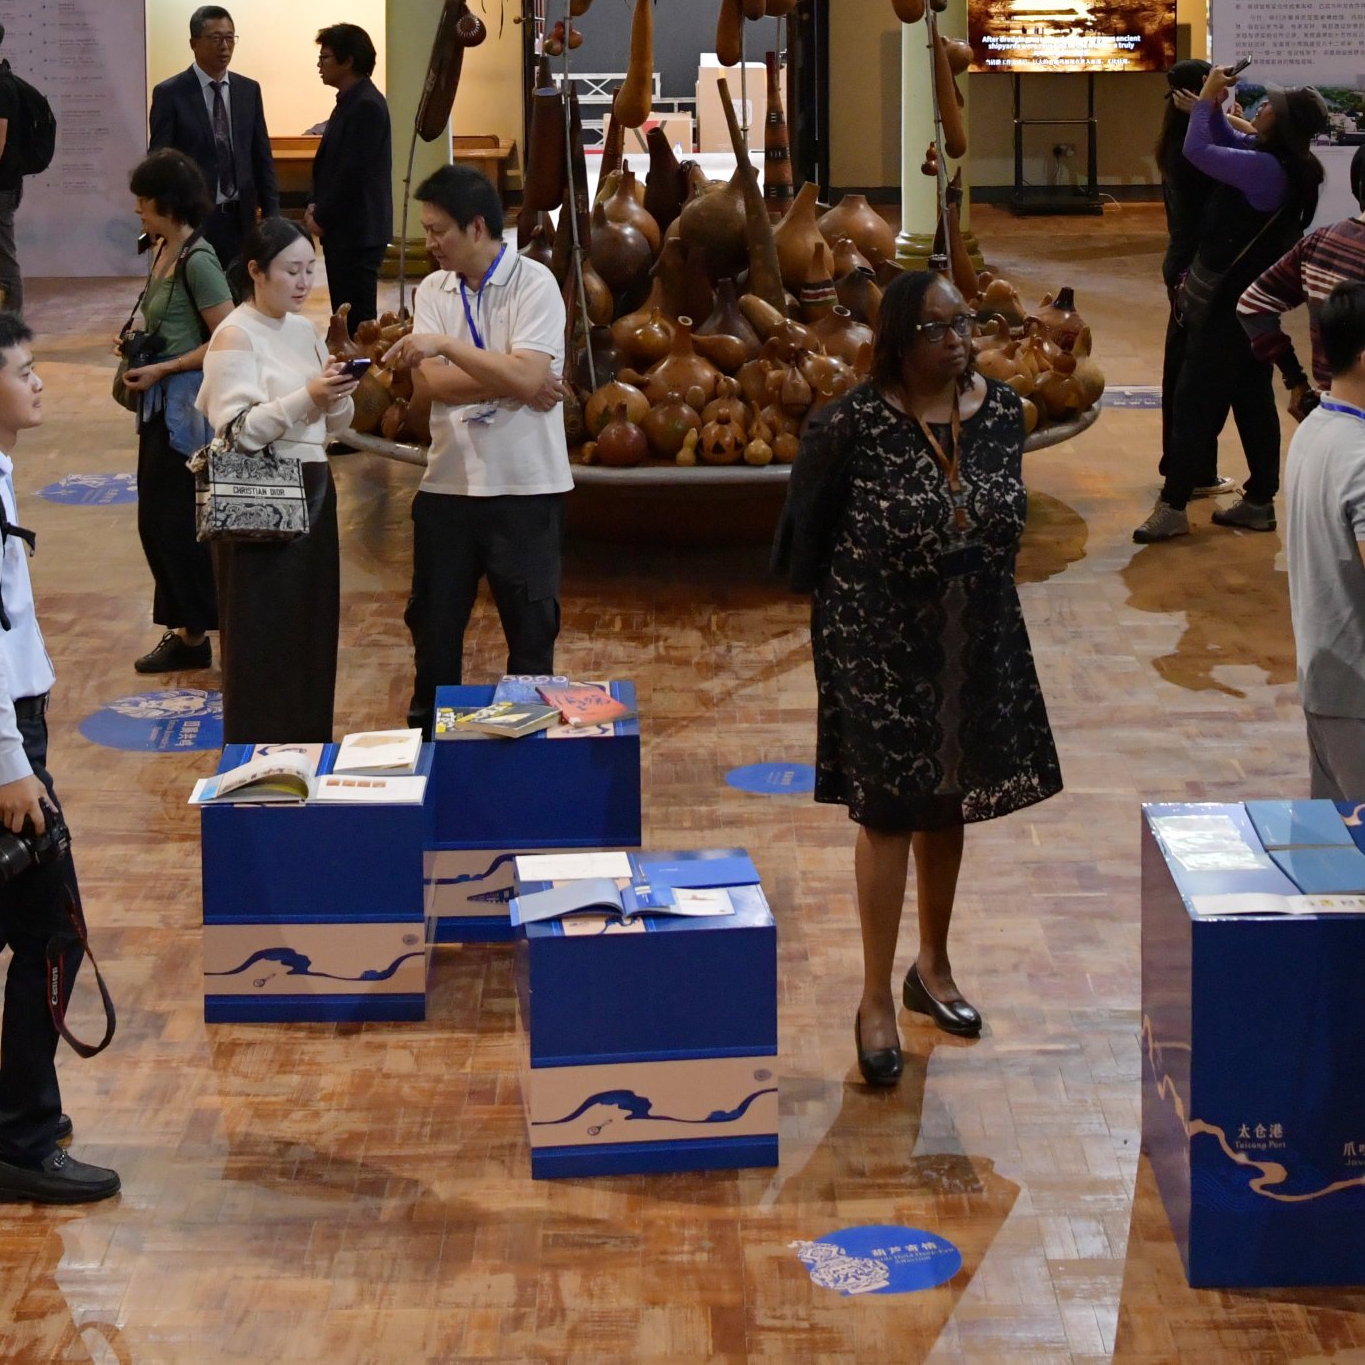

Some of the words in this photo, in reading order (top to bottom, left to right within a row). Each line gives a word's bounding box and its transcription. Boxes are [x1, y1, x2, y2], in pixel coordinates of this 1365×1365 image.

[981, 35, 998, 43] After
[232, 486, 267, 495] CHRISTIAN
[270, 488, 285, 496] DIOR
[1237, 1122, 1282, 1138] 太仓港
[1235, 1140, 1266, 1149] Taicang
[1268, 1140, 1286, 1148] Port
[871, 1241, 937, 1256] 葫芦寄情
